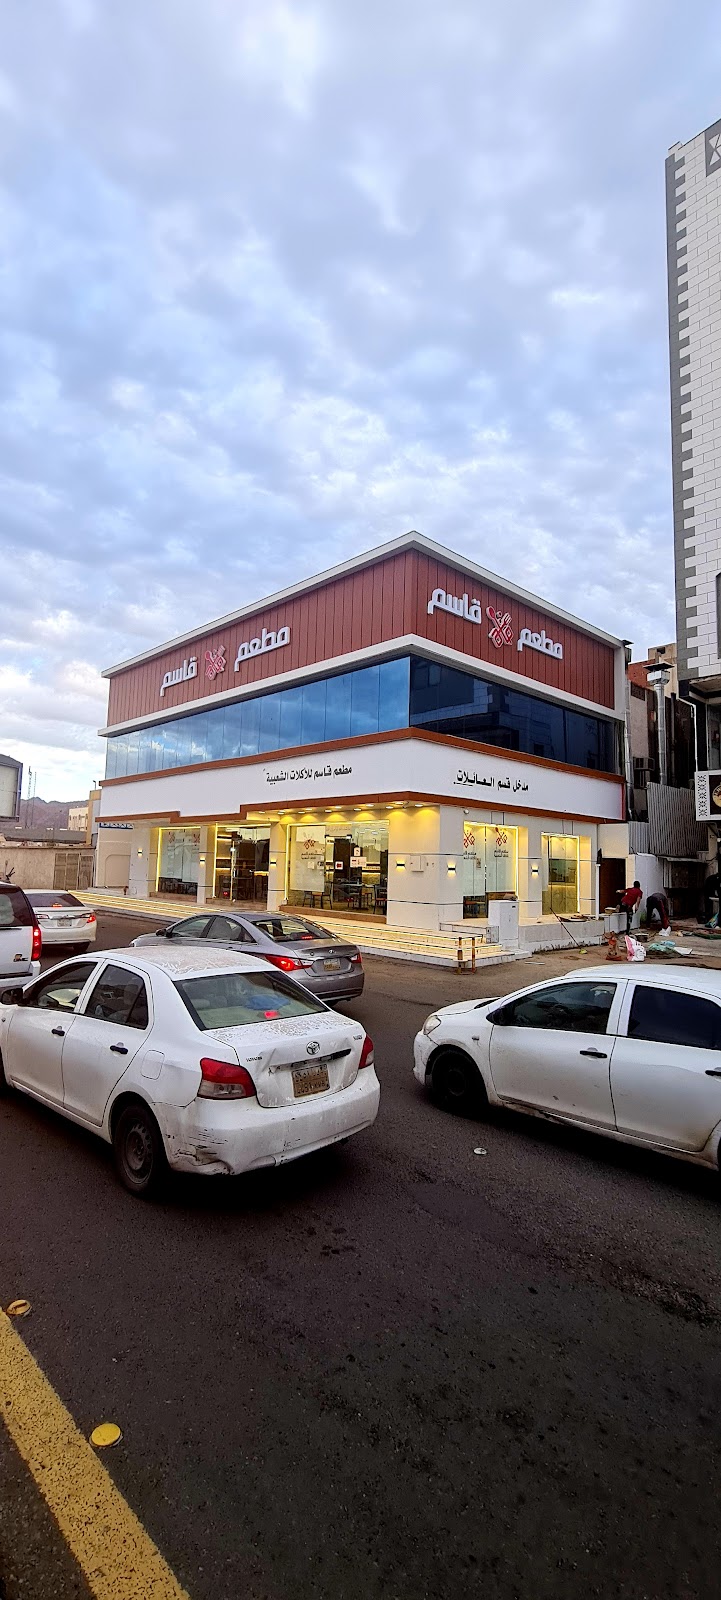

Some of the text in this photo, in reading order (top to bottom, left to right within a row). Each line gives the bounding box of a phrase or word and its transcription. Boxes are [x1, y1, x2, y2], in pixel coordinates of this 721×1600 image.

[427, 588, 563, 660] مطعم قاسم
[159, 626, 291, 697] مطعم قاسم
[266, 770, 289, 785] الشعبية
[313, 764, 332, 780] قاسم
[333, 764, 353, 778] مطعم
[497, 777, 511, 791] قسم
[512, 779, 529, 792] مدخل
